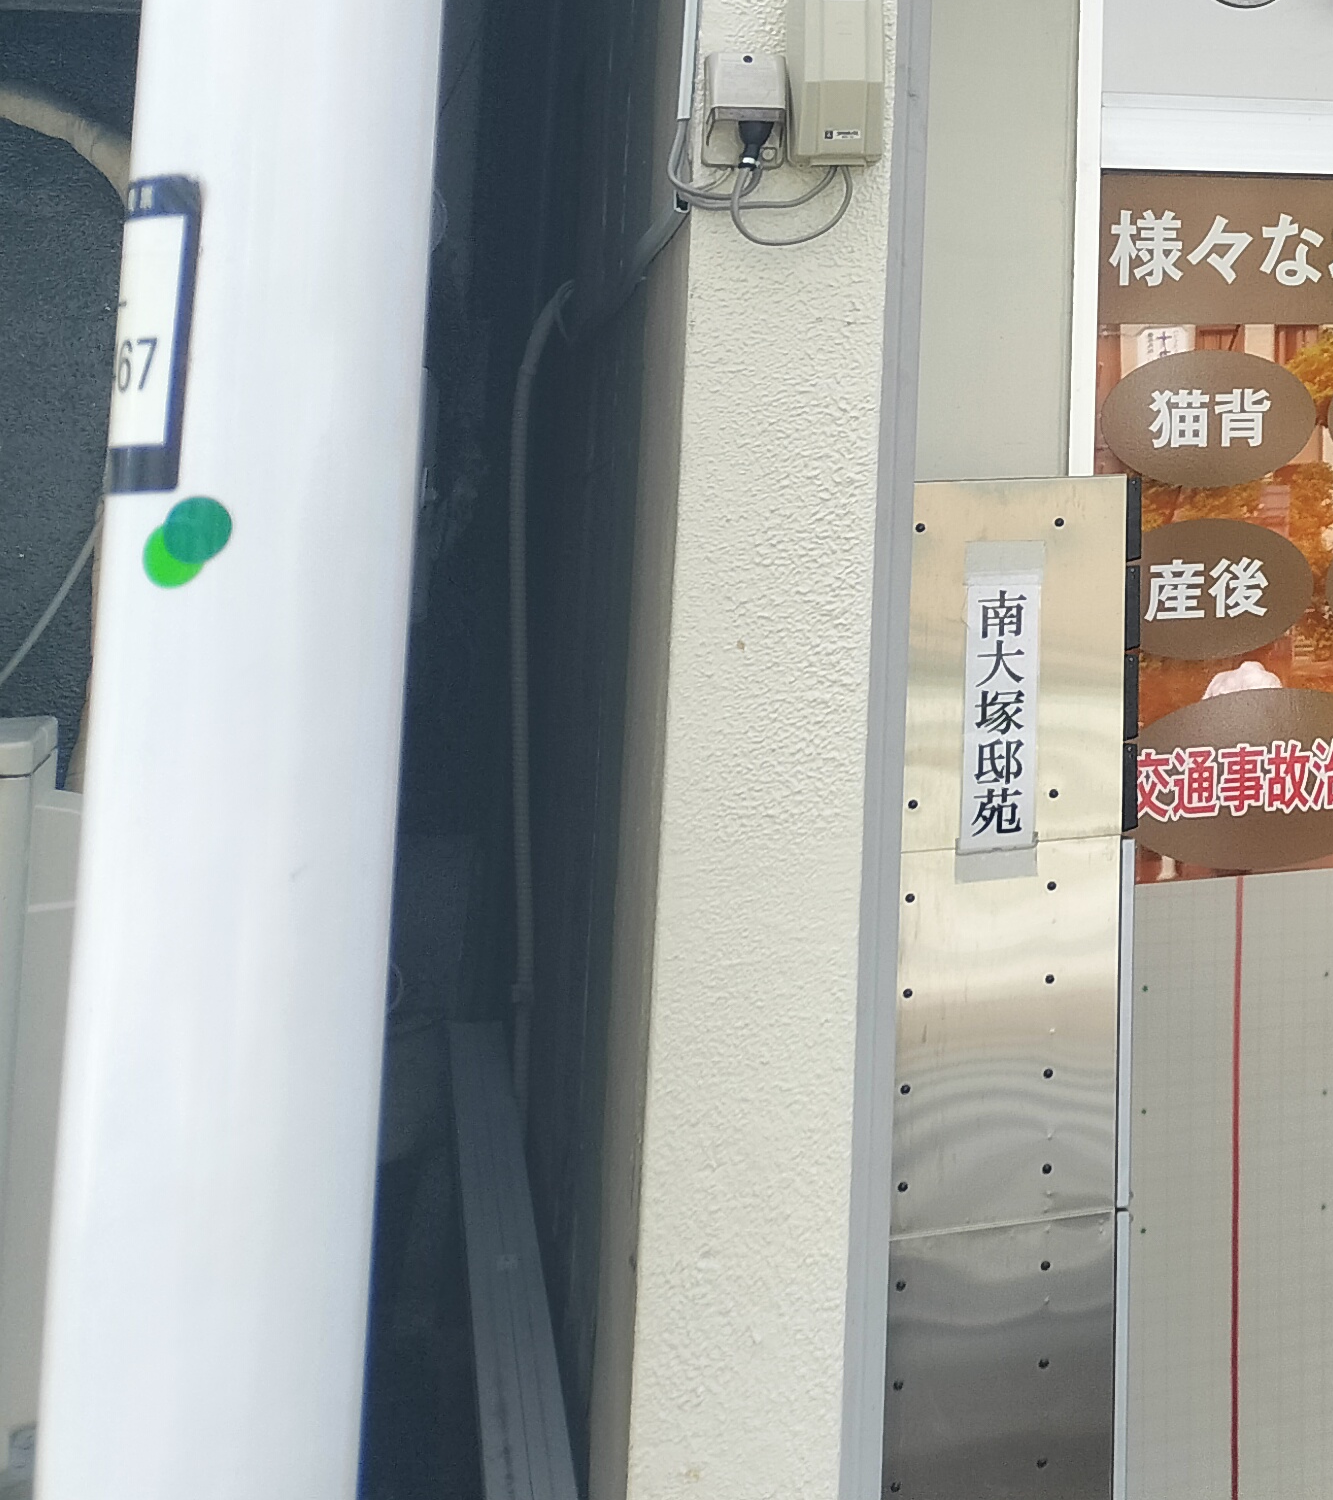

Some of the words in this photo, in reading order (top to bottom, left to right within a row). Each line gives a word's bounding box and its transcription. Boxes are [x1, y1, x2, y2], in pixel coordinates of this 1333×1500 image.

[1148, 388, 1272, 448] 猫背
[1144, 556, 1269, 621] 産後
[970, 590, 1028, 838] 南大塚邸苑
